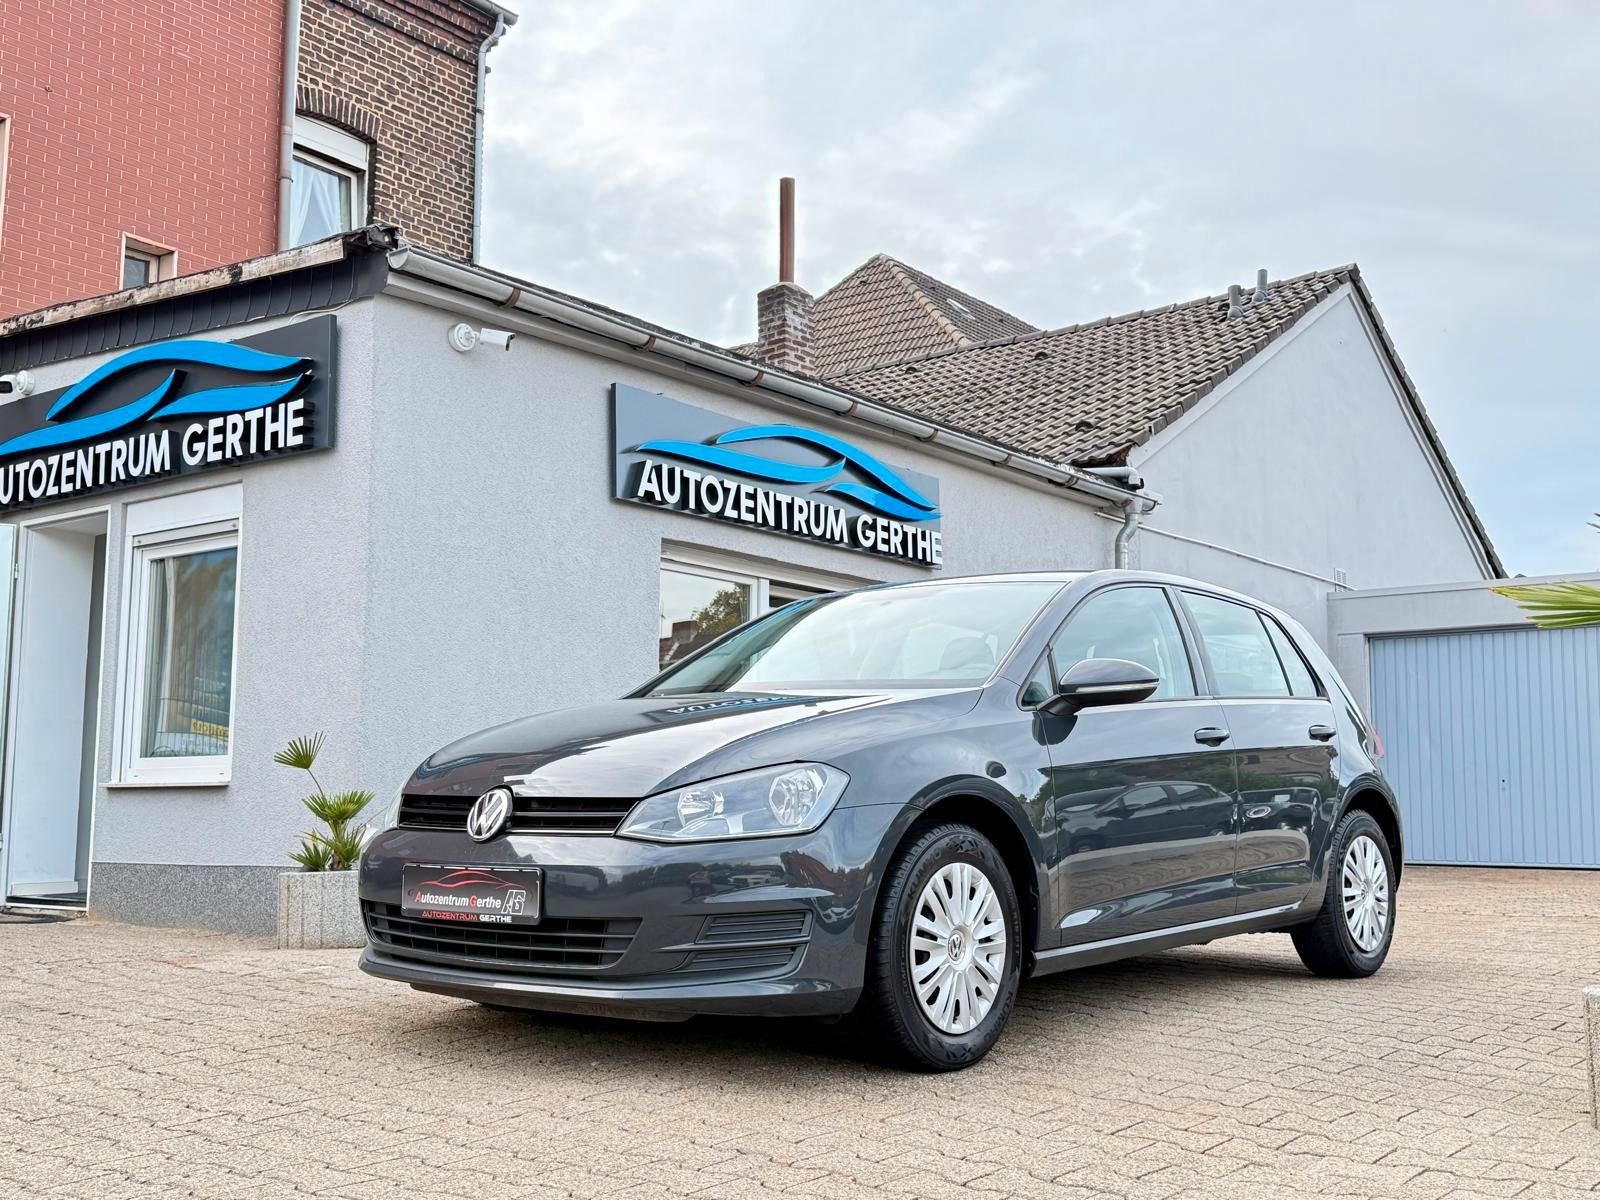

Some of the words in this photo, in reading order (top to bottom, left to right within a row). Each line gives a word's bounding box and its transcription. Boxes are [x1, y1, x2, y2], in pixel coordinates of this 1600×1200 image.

[182, 398, 305, 466] GERTHE
[637, 459, 849, 544] AUTOZENTRUM
[856, 514, 943, 565] GERTHE
[415, 891, 469, 907] Autozentrum
[469, 895, 501, 909] Gerthe
[422, 910, 478, 921] AUTOZENTRUM
[479, 914, 513, 923] GERTHE
